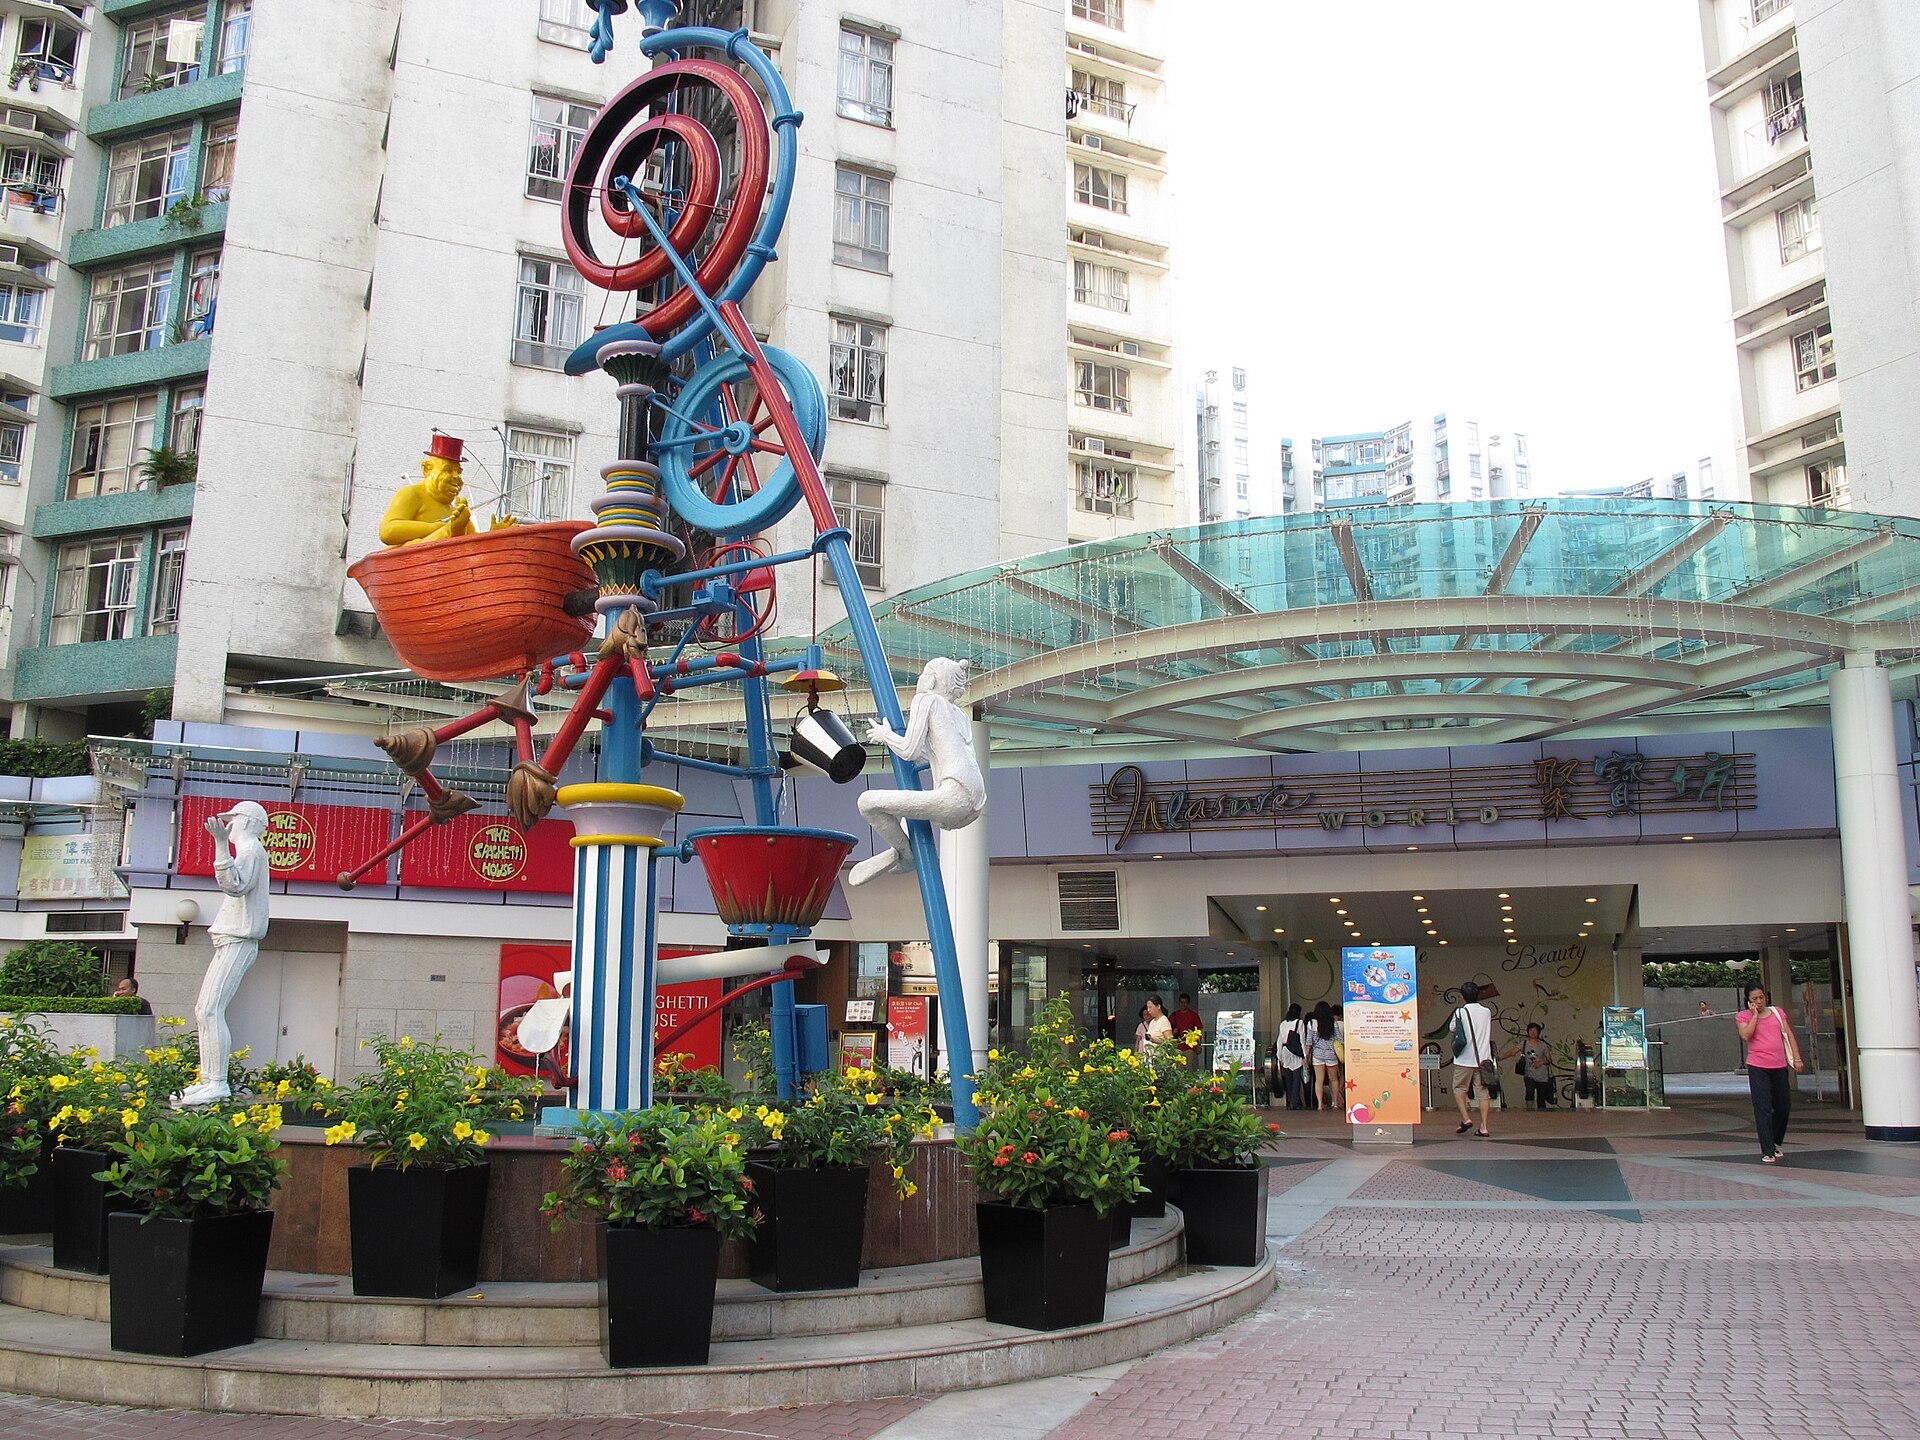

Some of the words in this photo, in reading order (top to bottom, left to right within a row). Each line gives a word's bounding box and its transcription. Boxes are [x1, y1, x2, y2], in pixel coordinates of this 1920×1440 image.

[270, 814, 298, 830] THE
[1318, 805, 1500, 832] WORLD
[485, 827, 511, 843] THE
[267, 850, 303, 867] HOUSE
[482, 861, 516, 878] HOUSE
[1501, 943, 1588, 978] Beauty
[655, 994, 709, 1010] GHETTI
